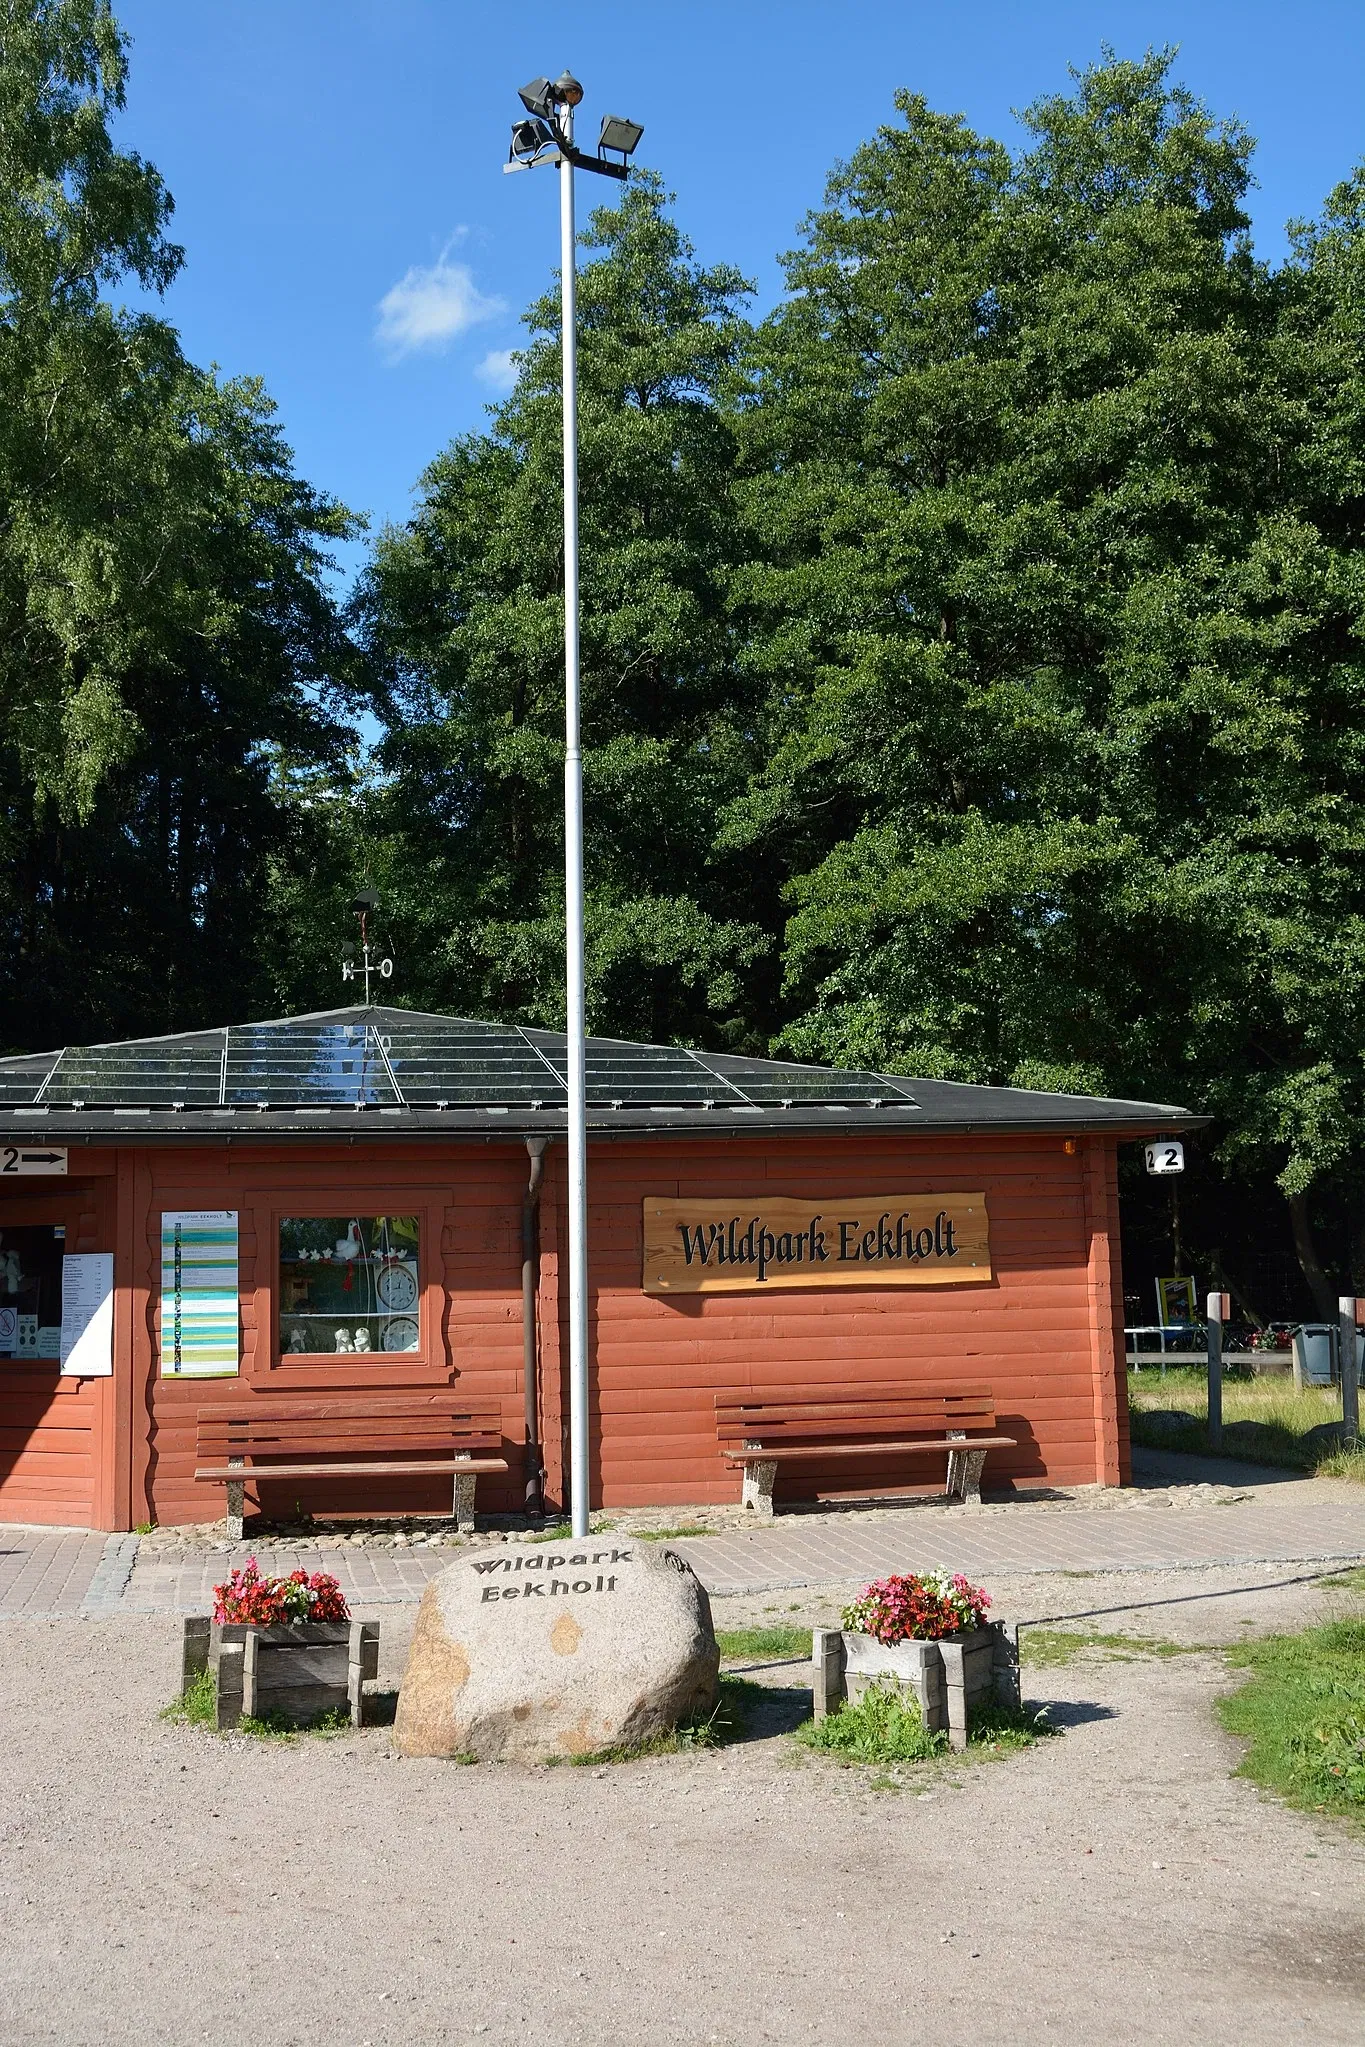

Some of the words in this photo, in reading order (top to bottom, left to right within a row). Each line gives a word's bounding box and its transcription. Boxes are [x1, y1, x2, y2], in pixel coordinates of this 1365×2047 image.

[381, 958, 393, 978] O
[2, 1147, 19, 1172] 2
[1148, 1151, 1154, 1168] 2
[1165, 1149, 1178, 1166] 2
[679, 1214, 831, 1282] Wildpark
[836, 1210, 960, 1262] Eekholt
[470, 1548, 634, 1576] Wildpark
[480, 1575, 619, 1604] Eekholt
